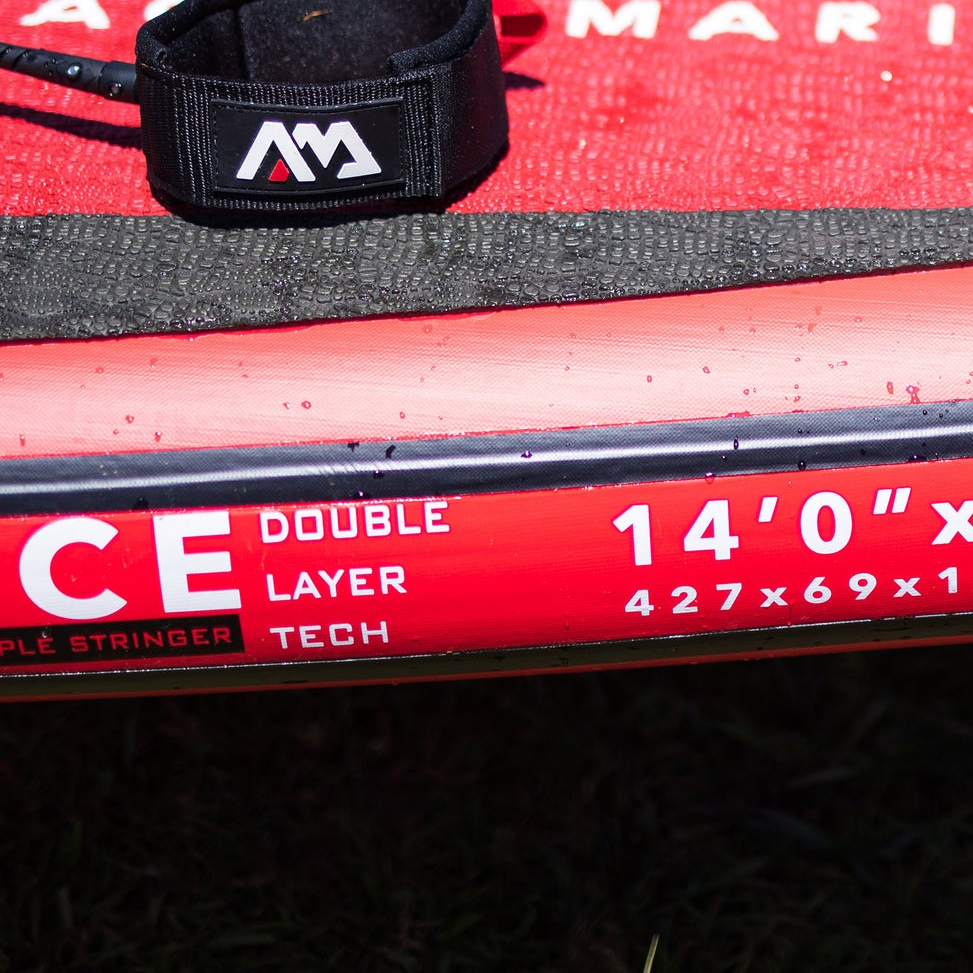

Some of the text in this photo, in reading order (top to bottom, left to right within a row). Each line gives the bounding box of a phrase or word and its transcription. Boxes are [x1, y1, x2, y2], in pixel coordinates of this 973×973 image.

[259, 501, 451, 544] DOUBLE
[266, 565, 407, 602] LAYER
[69, 627, 232, 654] STRINGER
[269, 621, 389, 649] TECH
